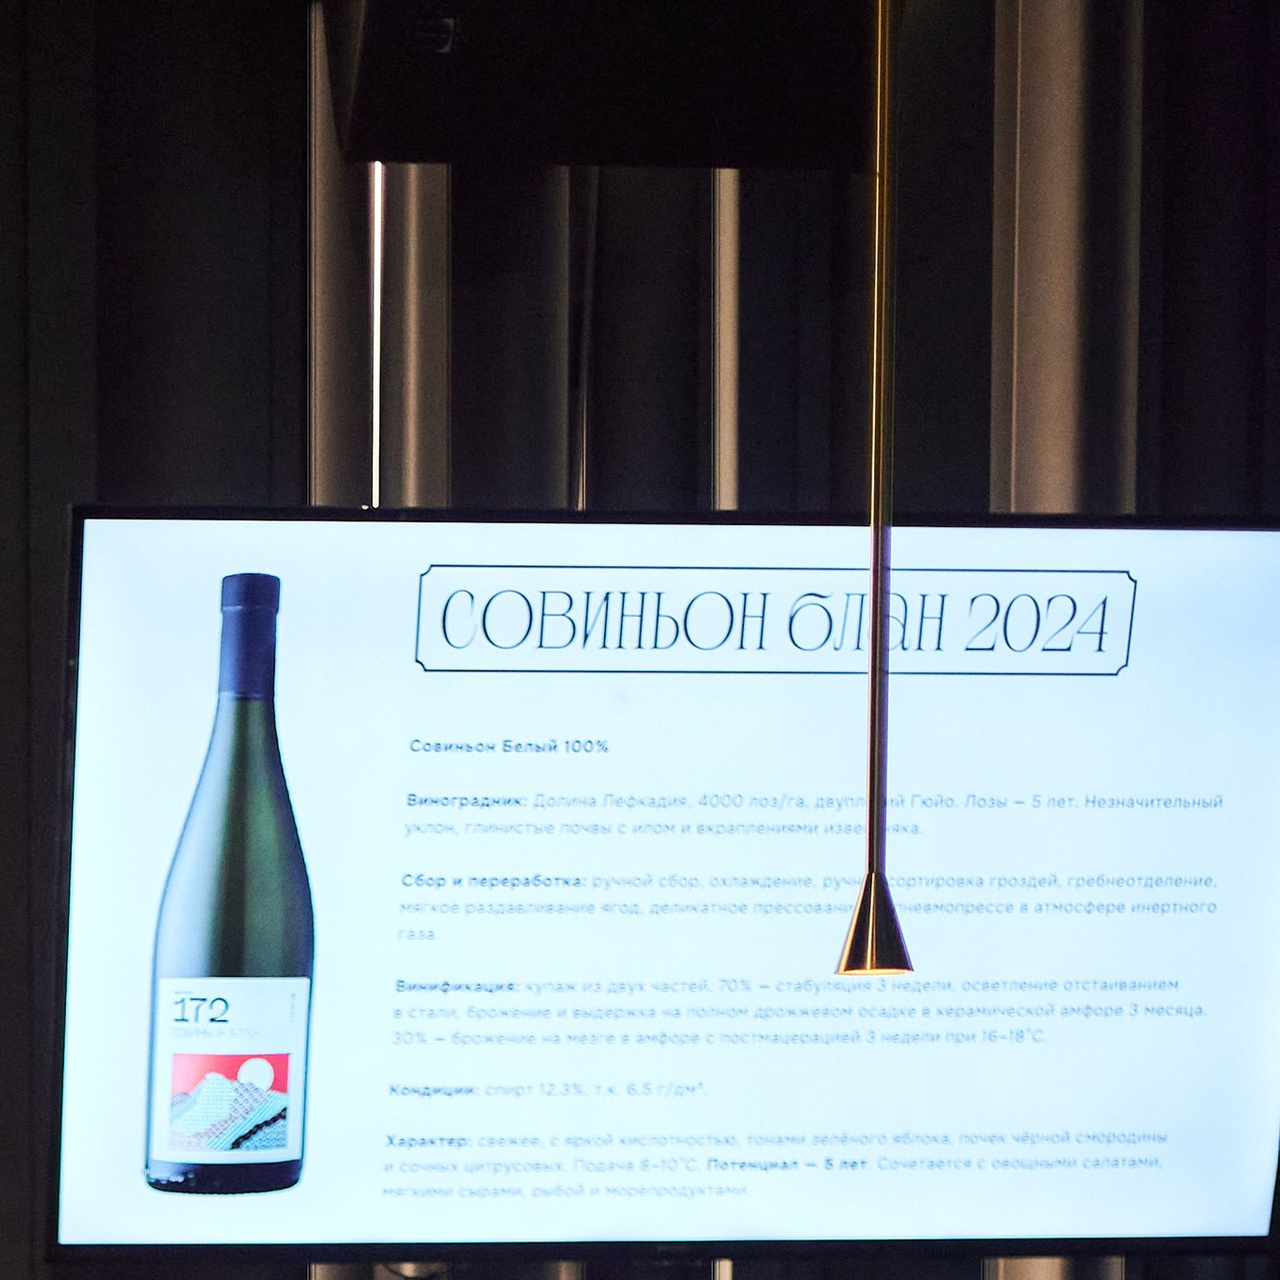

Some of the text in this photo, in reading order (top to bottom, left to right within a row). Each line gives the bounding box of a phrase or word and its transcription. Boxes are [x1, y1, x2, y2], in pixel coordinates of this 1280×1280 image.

[440, 590, 1109, 653] СОВИНЬОН блан 2024
[409, 738, 610, 753] Совиньон Белый 100%
[1031, 794, 1042, 808] 5
[753, 904, 854, 918] прессовани
[877, 978, 888, 992] 3
[175, 997, 228, 1022] 172
[1129, 1003, 1140, 1017] 3
[866, 1029, 877, 1044] 3
[824, 1156, 835, 1170] 5
